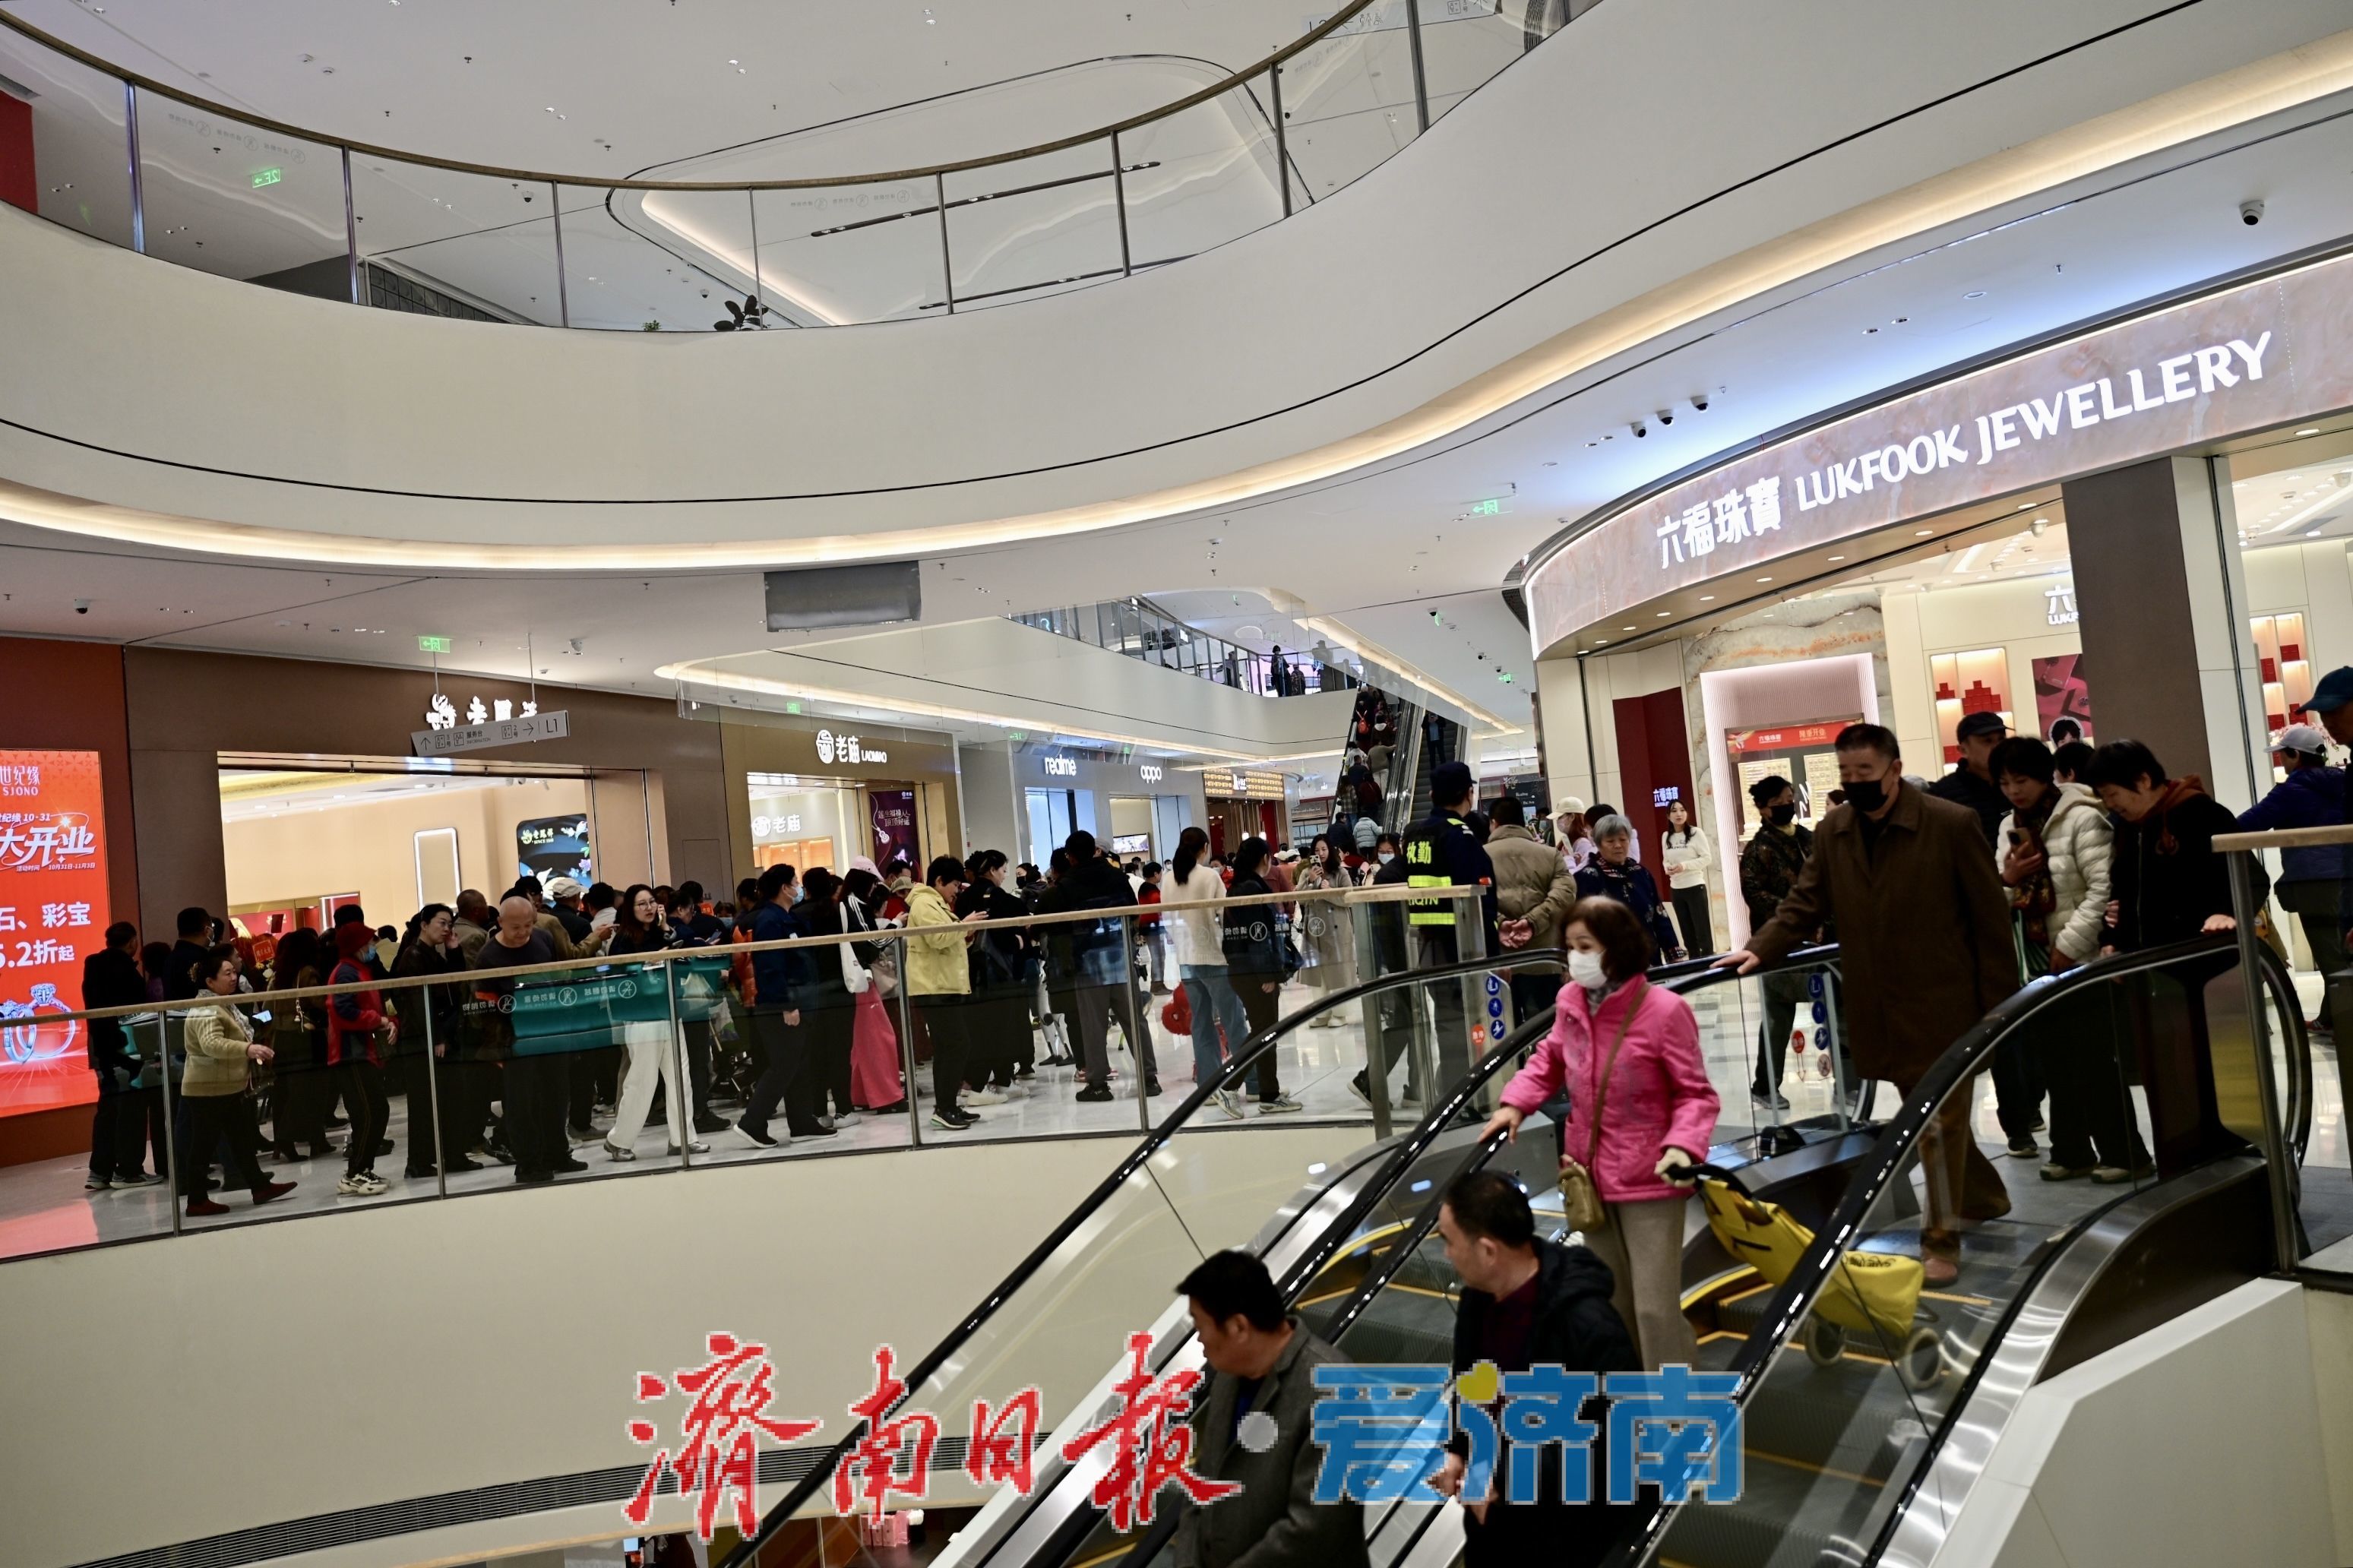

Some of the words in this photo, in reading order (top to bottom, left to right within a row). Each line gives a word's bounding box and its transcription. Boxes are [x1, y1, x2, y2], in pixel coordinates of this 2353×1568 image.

[1795, 423, 1969, 512] LUKFOOK
[1976, 330, 2272, 465] JEWELLERY
[1656, 476, 1782, 569] 六福珠寶
[466, 730, 482, 739] 服务台
[546, 719, 558, 733] L1
[836, 734, 860, 763] 老庙
[1045, 754, 1077, 776] realme
[1140, 765, 1162, 783] oppo
[772, 814, 801, 833] 老庙
[1406, 840, 1431, 864] 执勤
